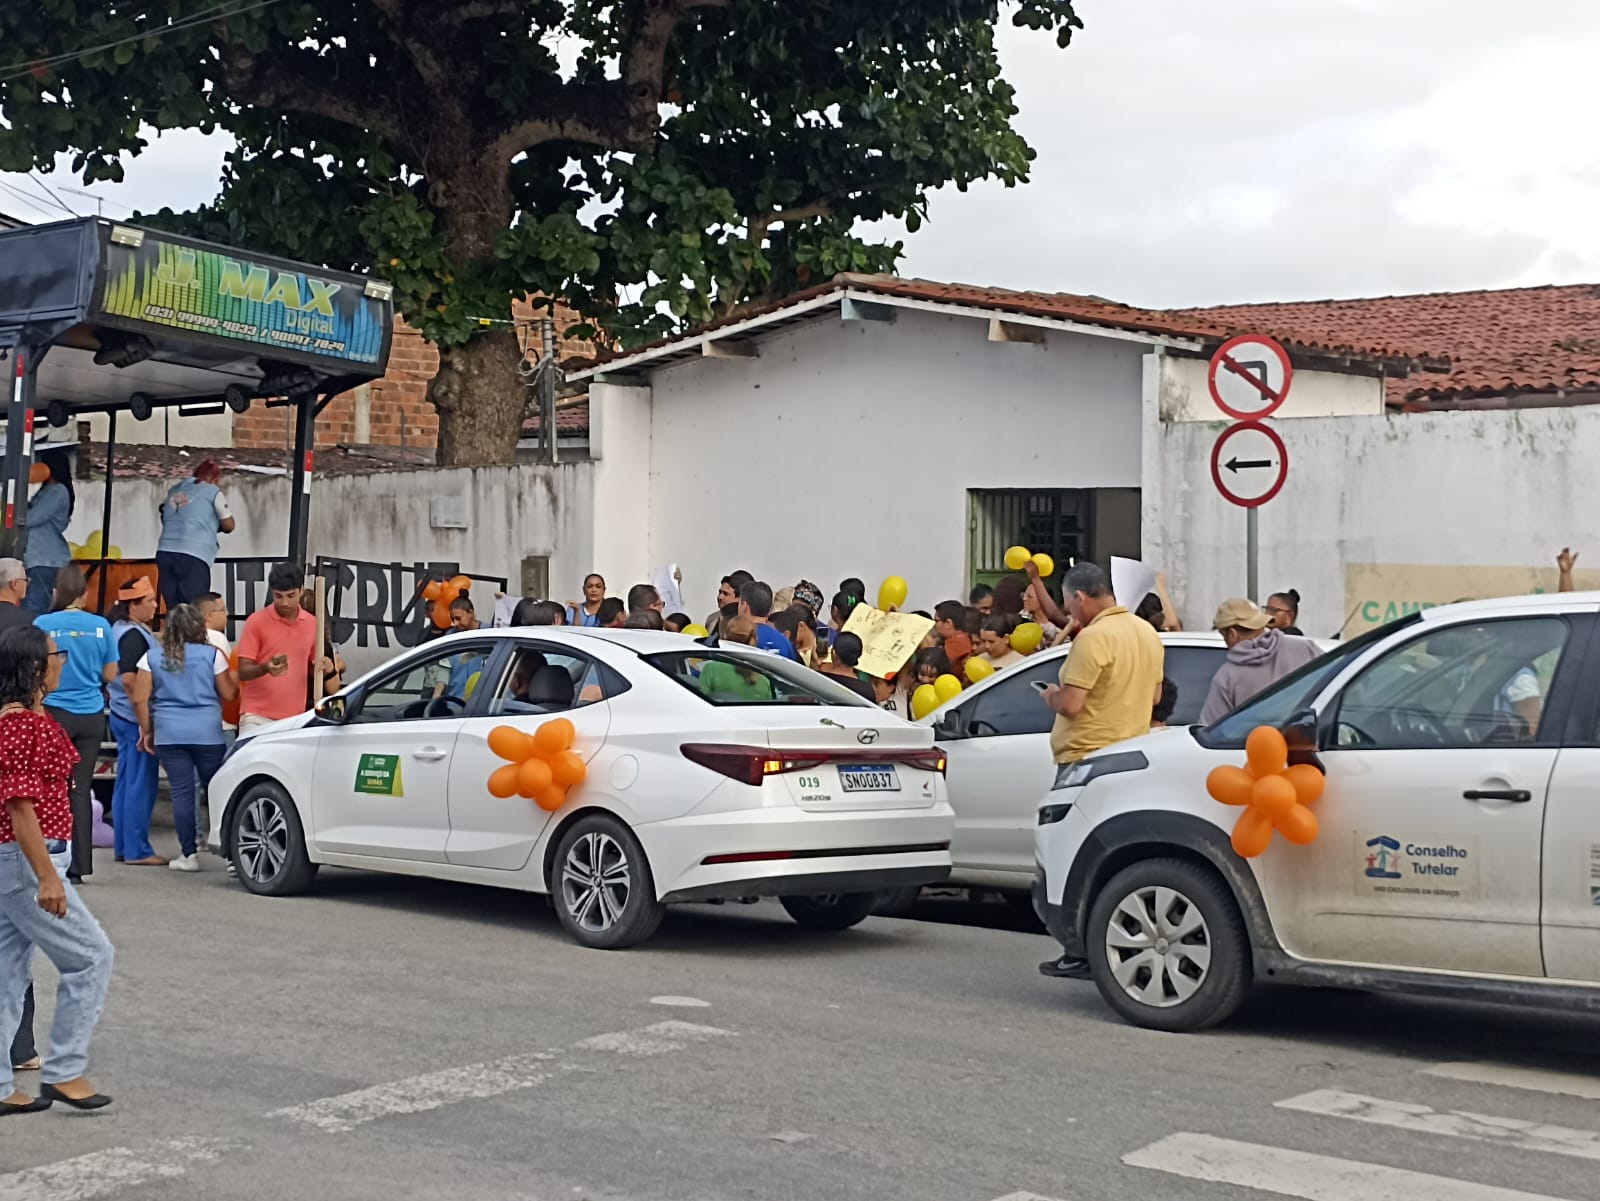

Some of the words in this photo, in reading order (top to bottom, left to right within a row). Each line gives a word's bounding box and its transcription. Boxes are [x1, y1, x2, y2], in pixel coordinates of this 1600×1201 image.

[219, 261, 341, 316] MAX
[286, 309, 335, 336] Digital
[799, 777, 820, 788] 019
[1406, 844, 1467, 858] Conselho
[1412, 862, 1459, 876] Tutelar
